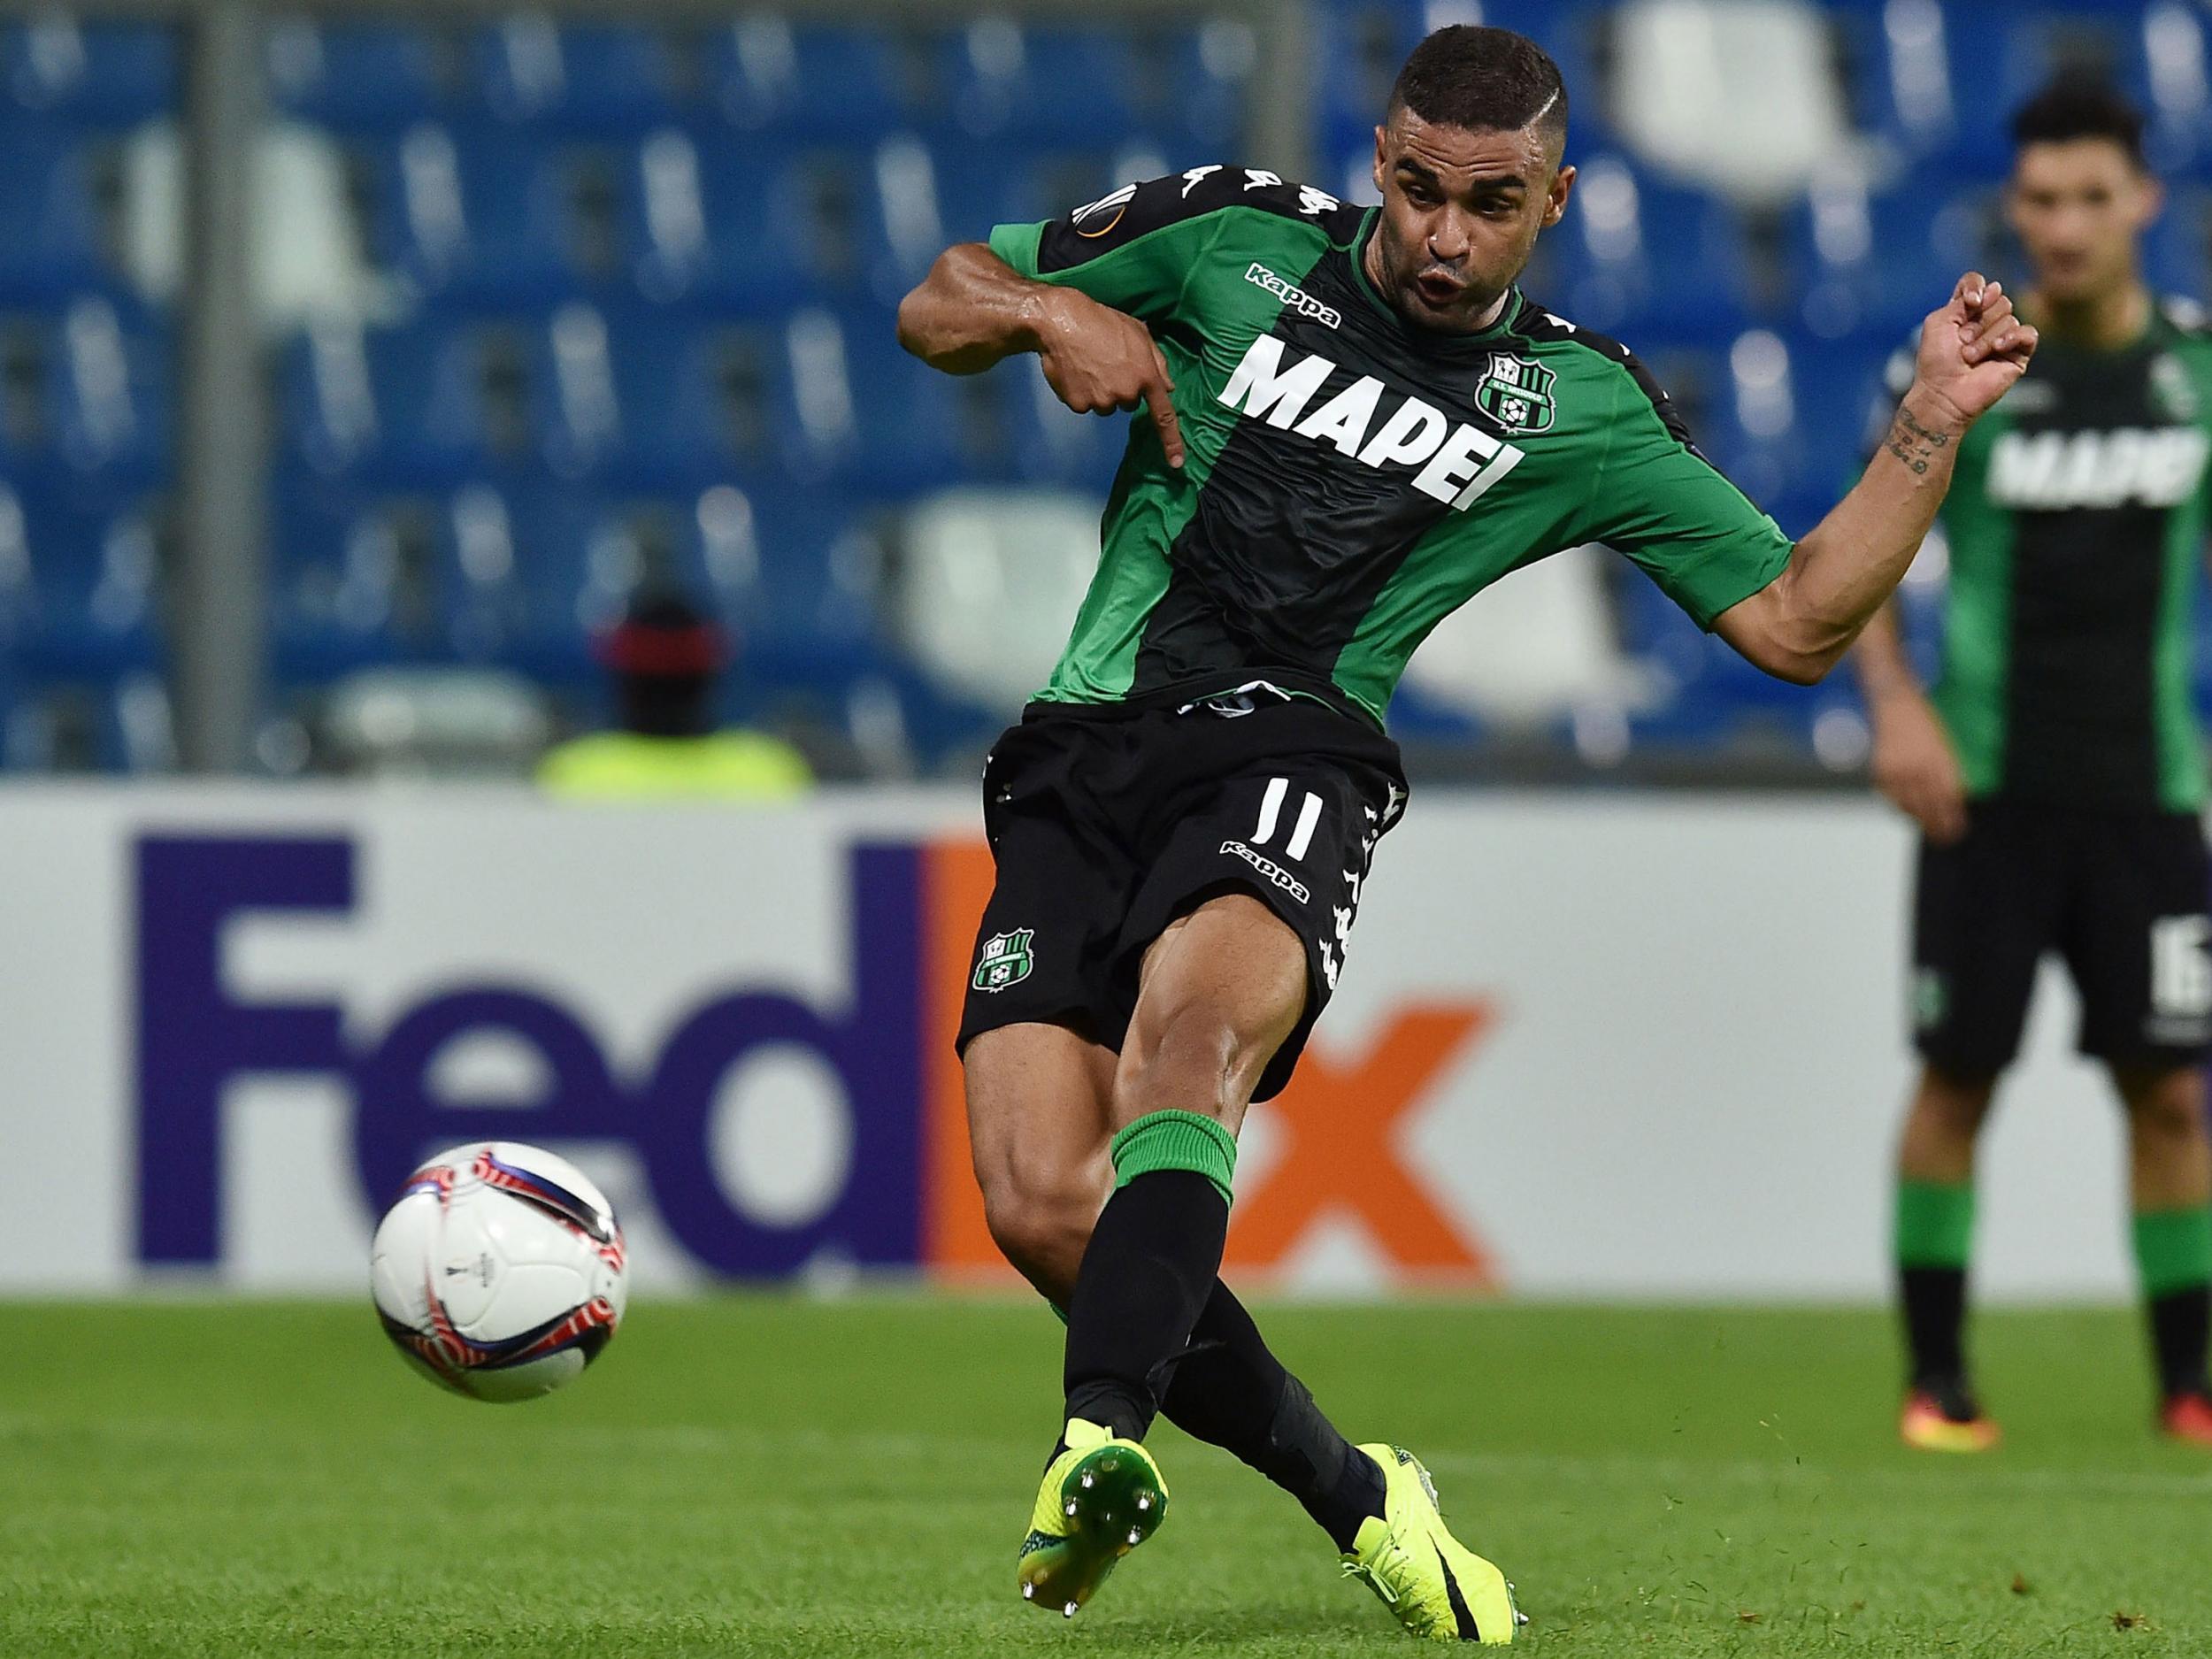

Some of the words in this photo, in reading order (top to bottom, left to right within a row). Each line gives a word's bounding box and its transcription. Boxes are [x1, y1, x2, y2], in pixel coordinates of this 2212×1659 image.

[1244, 263, 1341, 329] Kappa
[1217, 333, 1525, 512] MAPEI
[1249, 777, 1324, 862] 11
[1219, 841, 1310, 904] Kappa
[131, 836, 1497, 1279] Fedx
